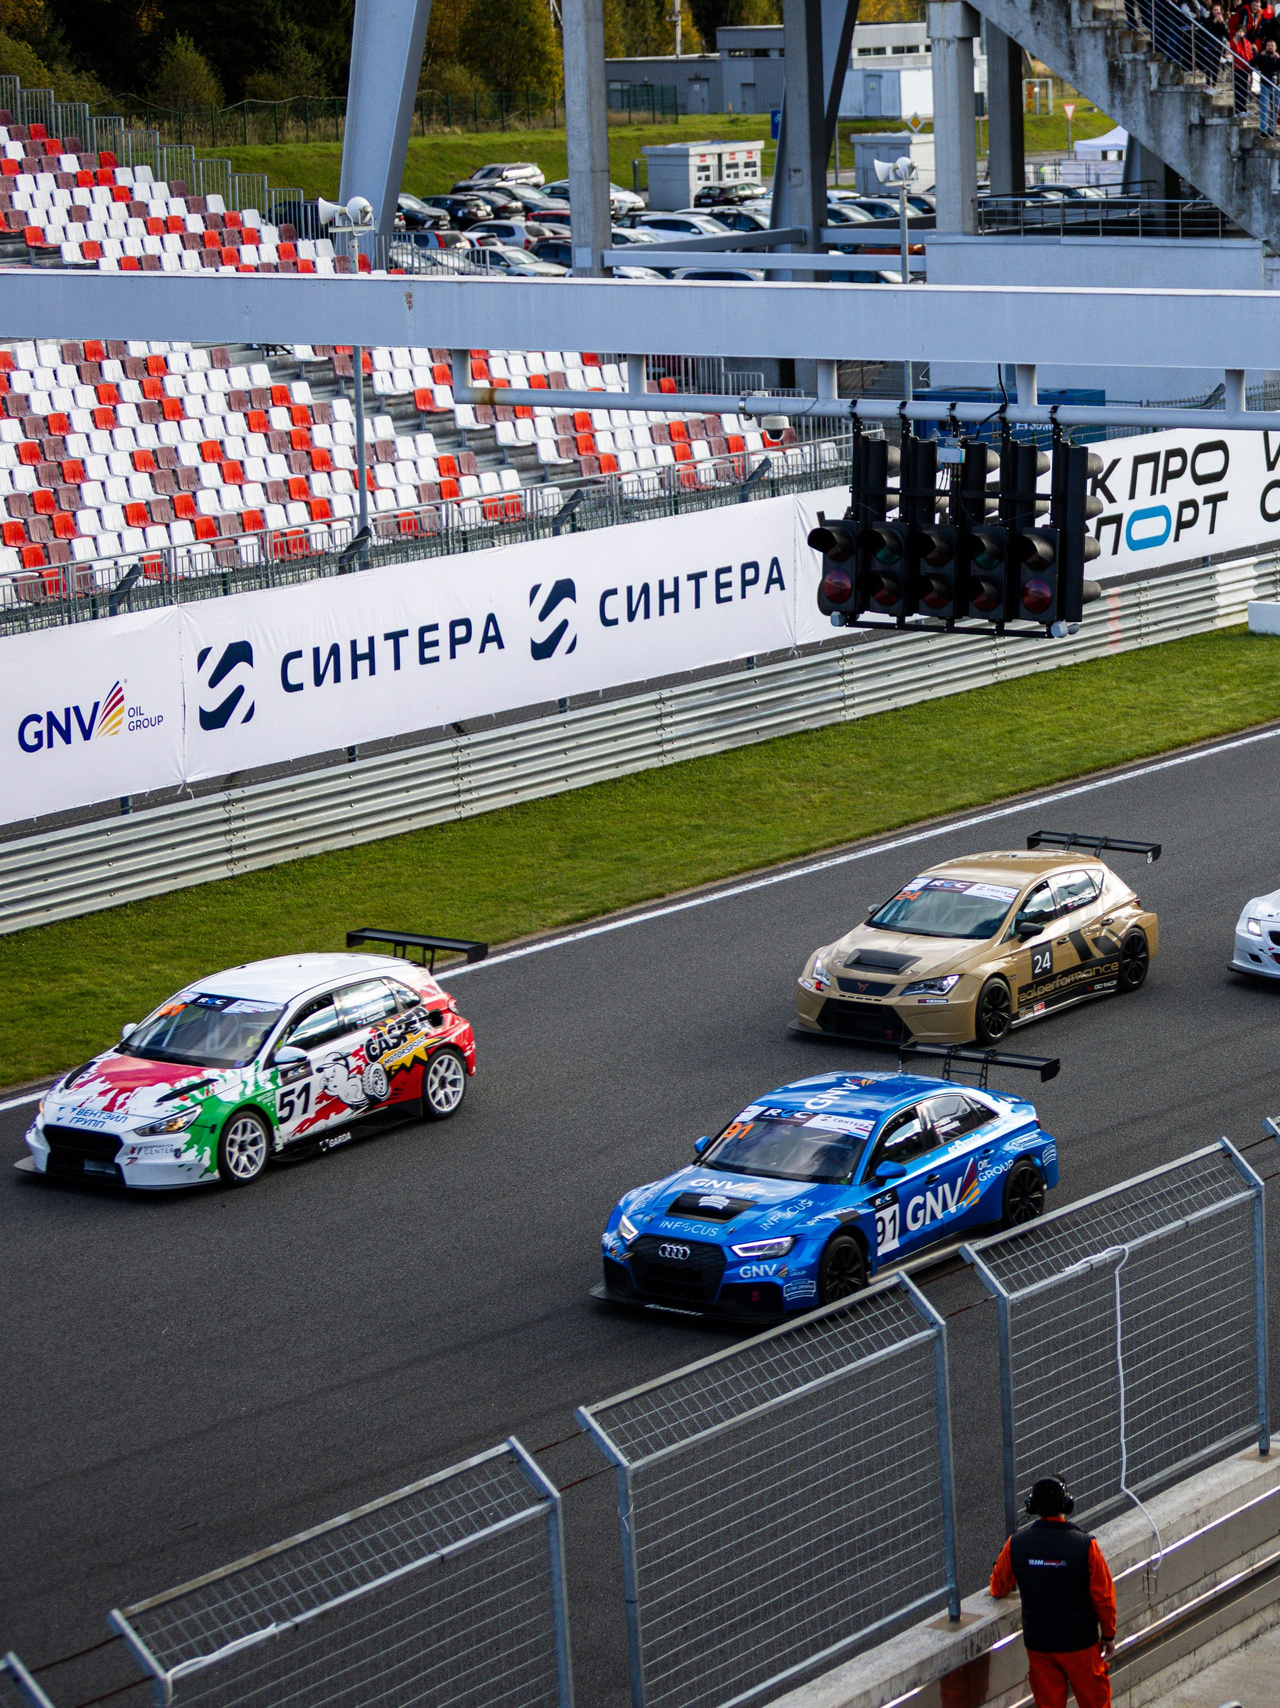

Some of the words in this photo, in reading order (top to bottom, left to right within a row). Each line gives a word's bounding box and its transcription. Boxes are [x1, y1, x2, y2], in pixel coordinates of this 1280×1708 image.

[1128, 439, 1230, 501] ПРО
[1085, 490, 1229, 556] ПОРТ
[600, 555, 786, 628] СИНТЕРА
[280, 612, 505, 693] СИНТЕРА
[128, 705, 144, 718] OIL
[18, 701, 100, 753] GNV
[128, 715, 164, 732] GROUP
[893, 890, 923, 901] 24
[1034, 951, 1052, 974] 24
[157, 1003, 188, 1017] 51
[278, 1082, 311, 1124] 51
[804, 1078, 860, 1110] GNV
[69, 1116, 106, 1129] ГРУПП
[723, 1122, 755, 1140] 91
[833, 1118, 870, 1130] СИНТЕРА
[978, 1159, 1014, 1183] GROUP
[689, 1178, 746, 1190] GNV
[906, 1176, 963, 1231] GNV
[876, 1213, 897, 1248] 91
[739, 1263, 778, 1279] GNV
